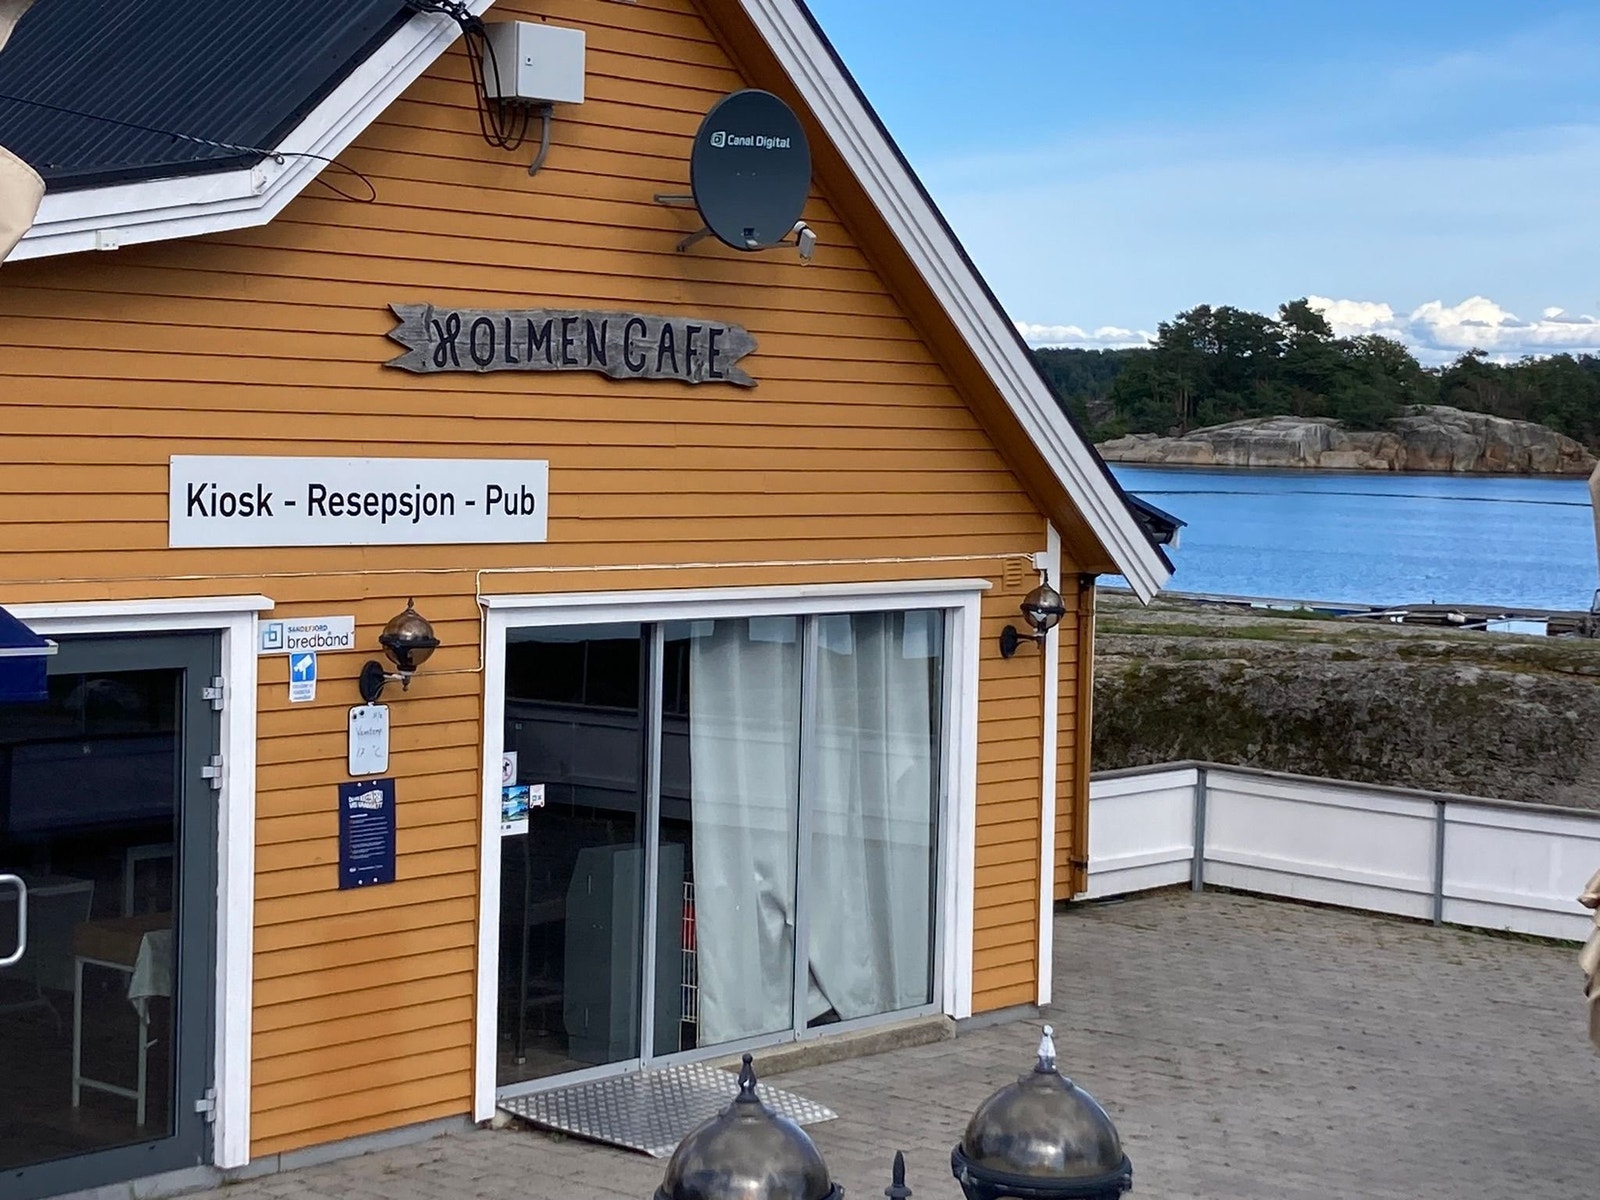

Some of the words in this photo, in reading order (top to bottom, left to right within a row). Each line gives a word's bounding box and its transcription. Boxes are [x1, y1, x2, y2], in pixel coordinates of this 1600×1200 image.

[727, 134, 754, 146] Canal
[755, 135, 790, 149] Digital
[430, 311, 608, 368] HOLMEN
[622, 316, 725, 379] CAFE
[186, 482, 274, 517] Kiosk
[307, 483, 455, 524] Resepsjon
[485, 484, 535, 516] Pub
[287, 624, 329, 633] SANDEFJORD
[287, 631, 349, 649] bredbånd
